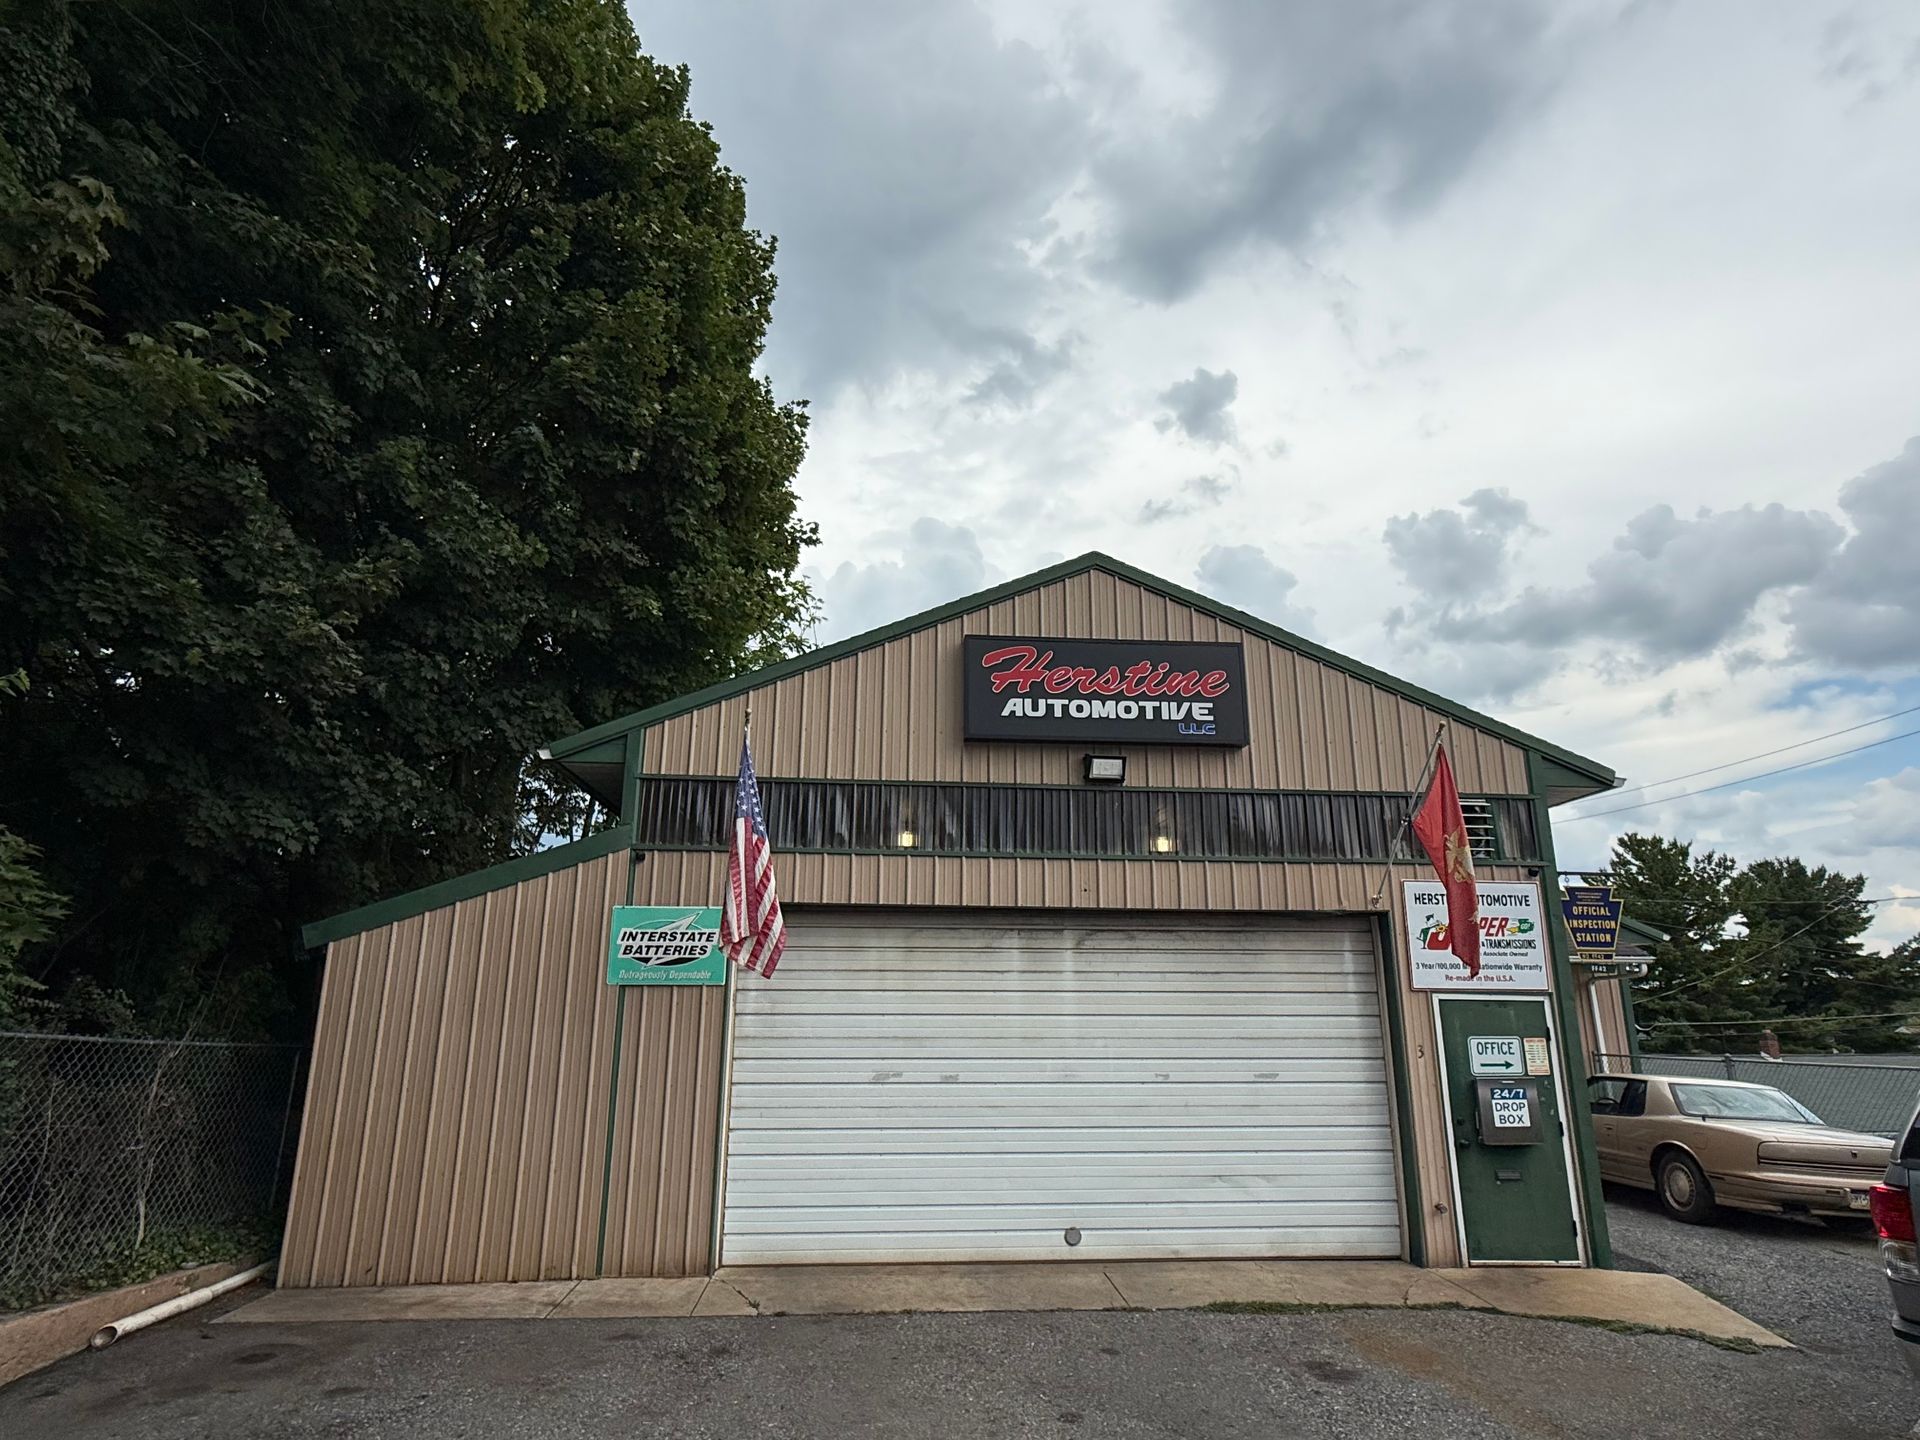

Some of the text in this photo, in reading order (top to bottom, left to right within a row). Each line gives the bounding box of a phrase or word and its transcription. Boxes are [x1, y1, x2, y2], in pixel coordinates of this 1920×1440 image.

[982, 646, 1230, 697] Herstine
[1001, 698, 1214, 721] AUTOMOTIVE
[1178, 723, 1216, 734] LLC
[1414, 893, 1446, 905] HERST
[1572, 906, 1611, 916] OFFICIAL
[1569, 920, 1616, 929] INSPECTION
[621, 931, 717, 943] INTERSTATE
[1576, 933, 1611, 942] STATION
[1485, 939, 1536, 949] TRANSMISSIONS
[622, 945, 708, 956] BATTERIES
[1481, 963, 1513, 971] ationwide
[1513, 964, 1543, 973] Warranty
[619, 970, 711, 980] Outrageously Dependable
[1445, 974, 1474, 982] Re-mad
[1476, 1041, 1515, 1055] OFFICE
[1493, 1089, 1524, 1099] 24/7
[1495, 1102, 1526, 1112] DROP
[1499, 1115, 1525, 1125] BOX
